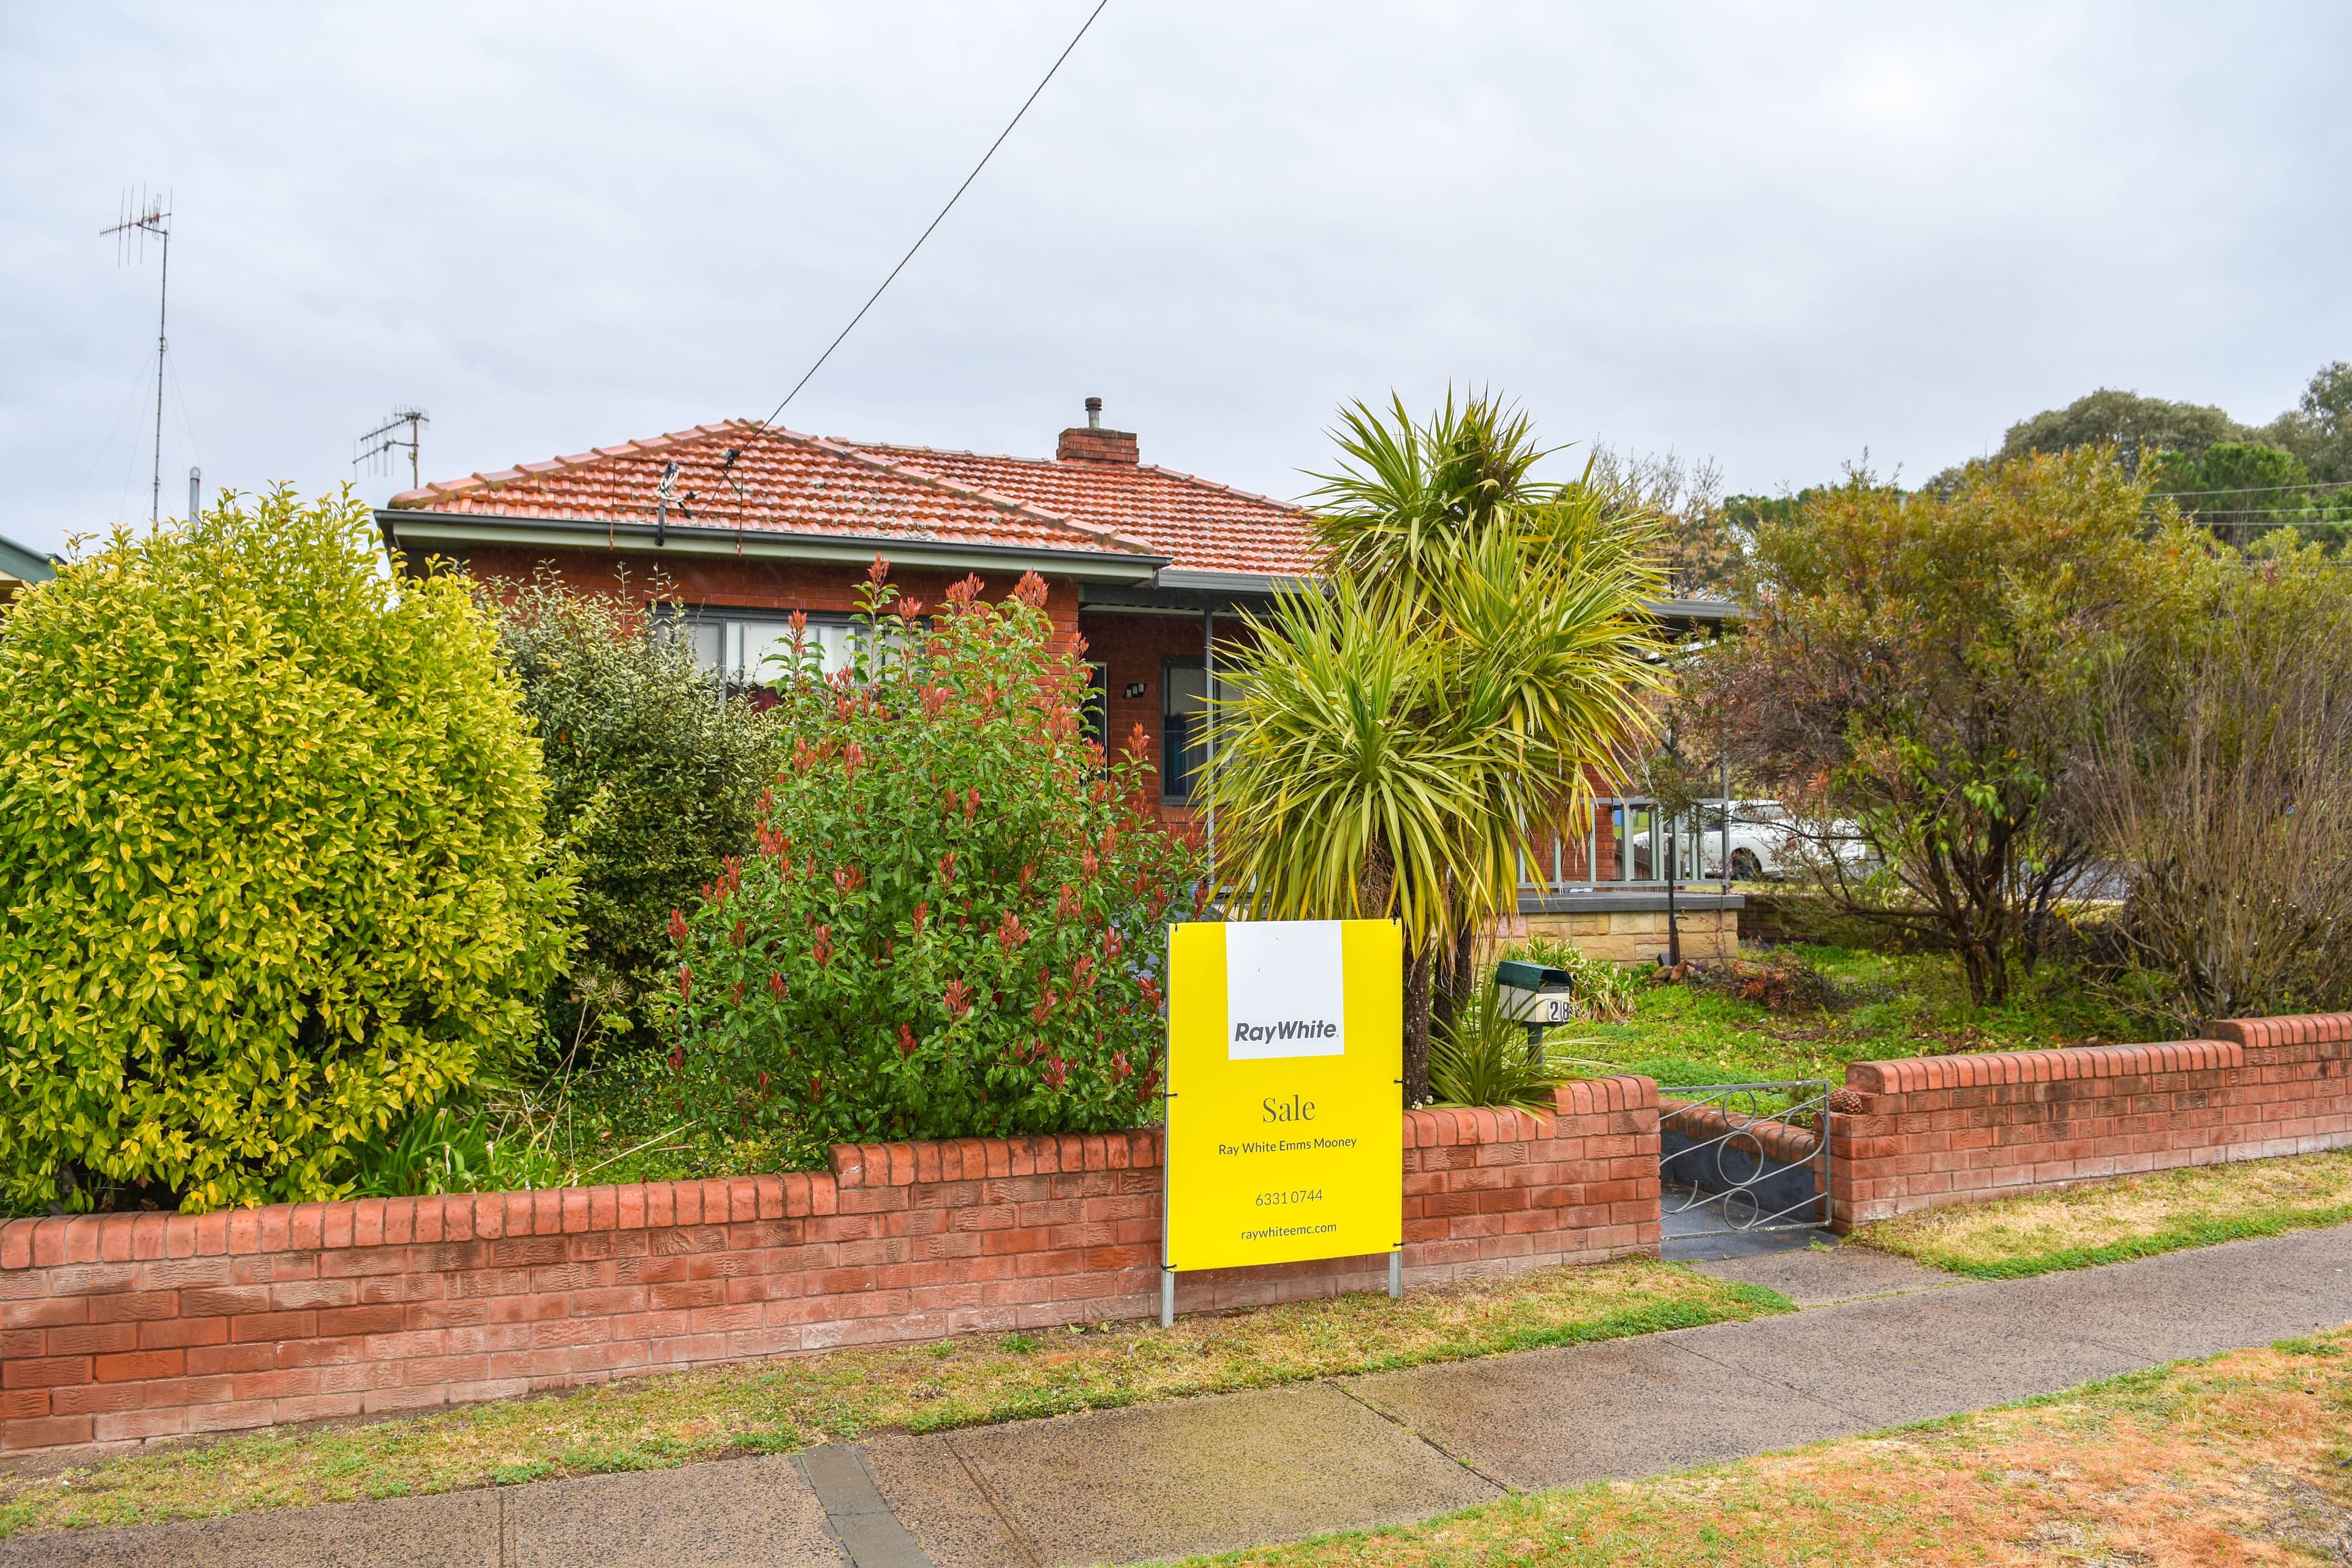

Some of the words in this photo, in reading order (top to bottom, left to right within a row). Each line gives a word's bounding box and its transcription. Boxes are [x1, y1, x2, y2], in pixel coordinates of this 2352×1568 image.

[1550, 1001, 1570, 1021] 28
[1262, 1094, 1316, 1123] Sale
[1218, 1144, 1240, 1156] Ray
[1242, 1141, 1277, 1154] White
[1279, 1140, 1311, 1152] Emms
[1314, 1137, 1357, 1149] Mooney
[1255, 1192, 1287, 1207] 6331
[1291, 1189, 1323, 1204] 0744
[1240, 1223, 1337, 1242] raywhiteemc.com
